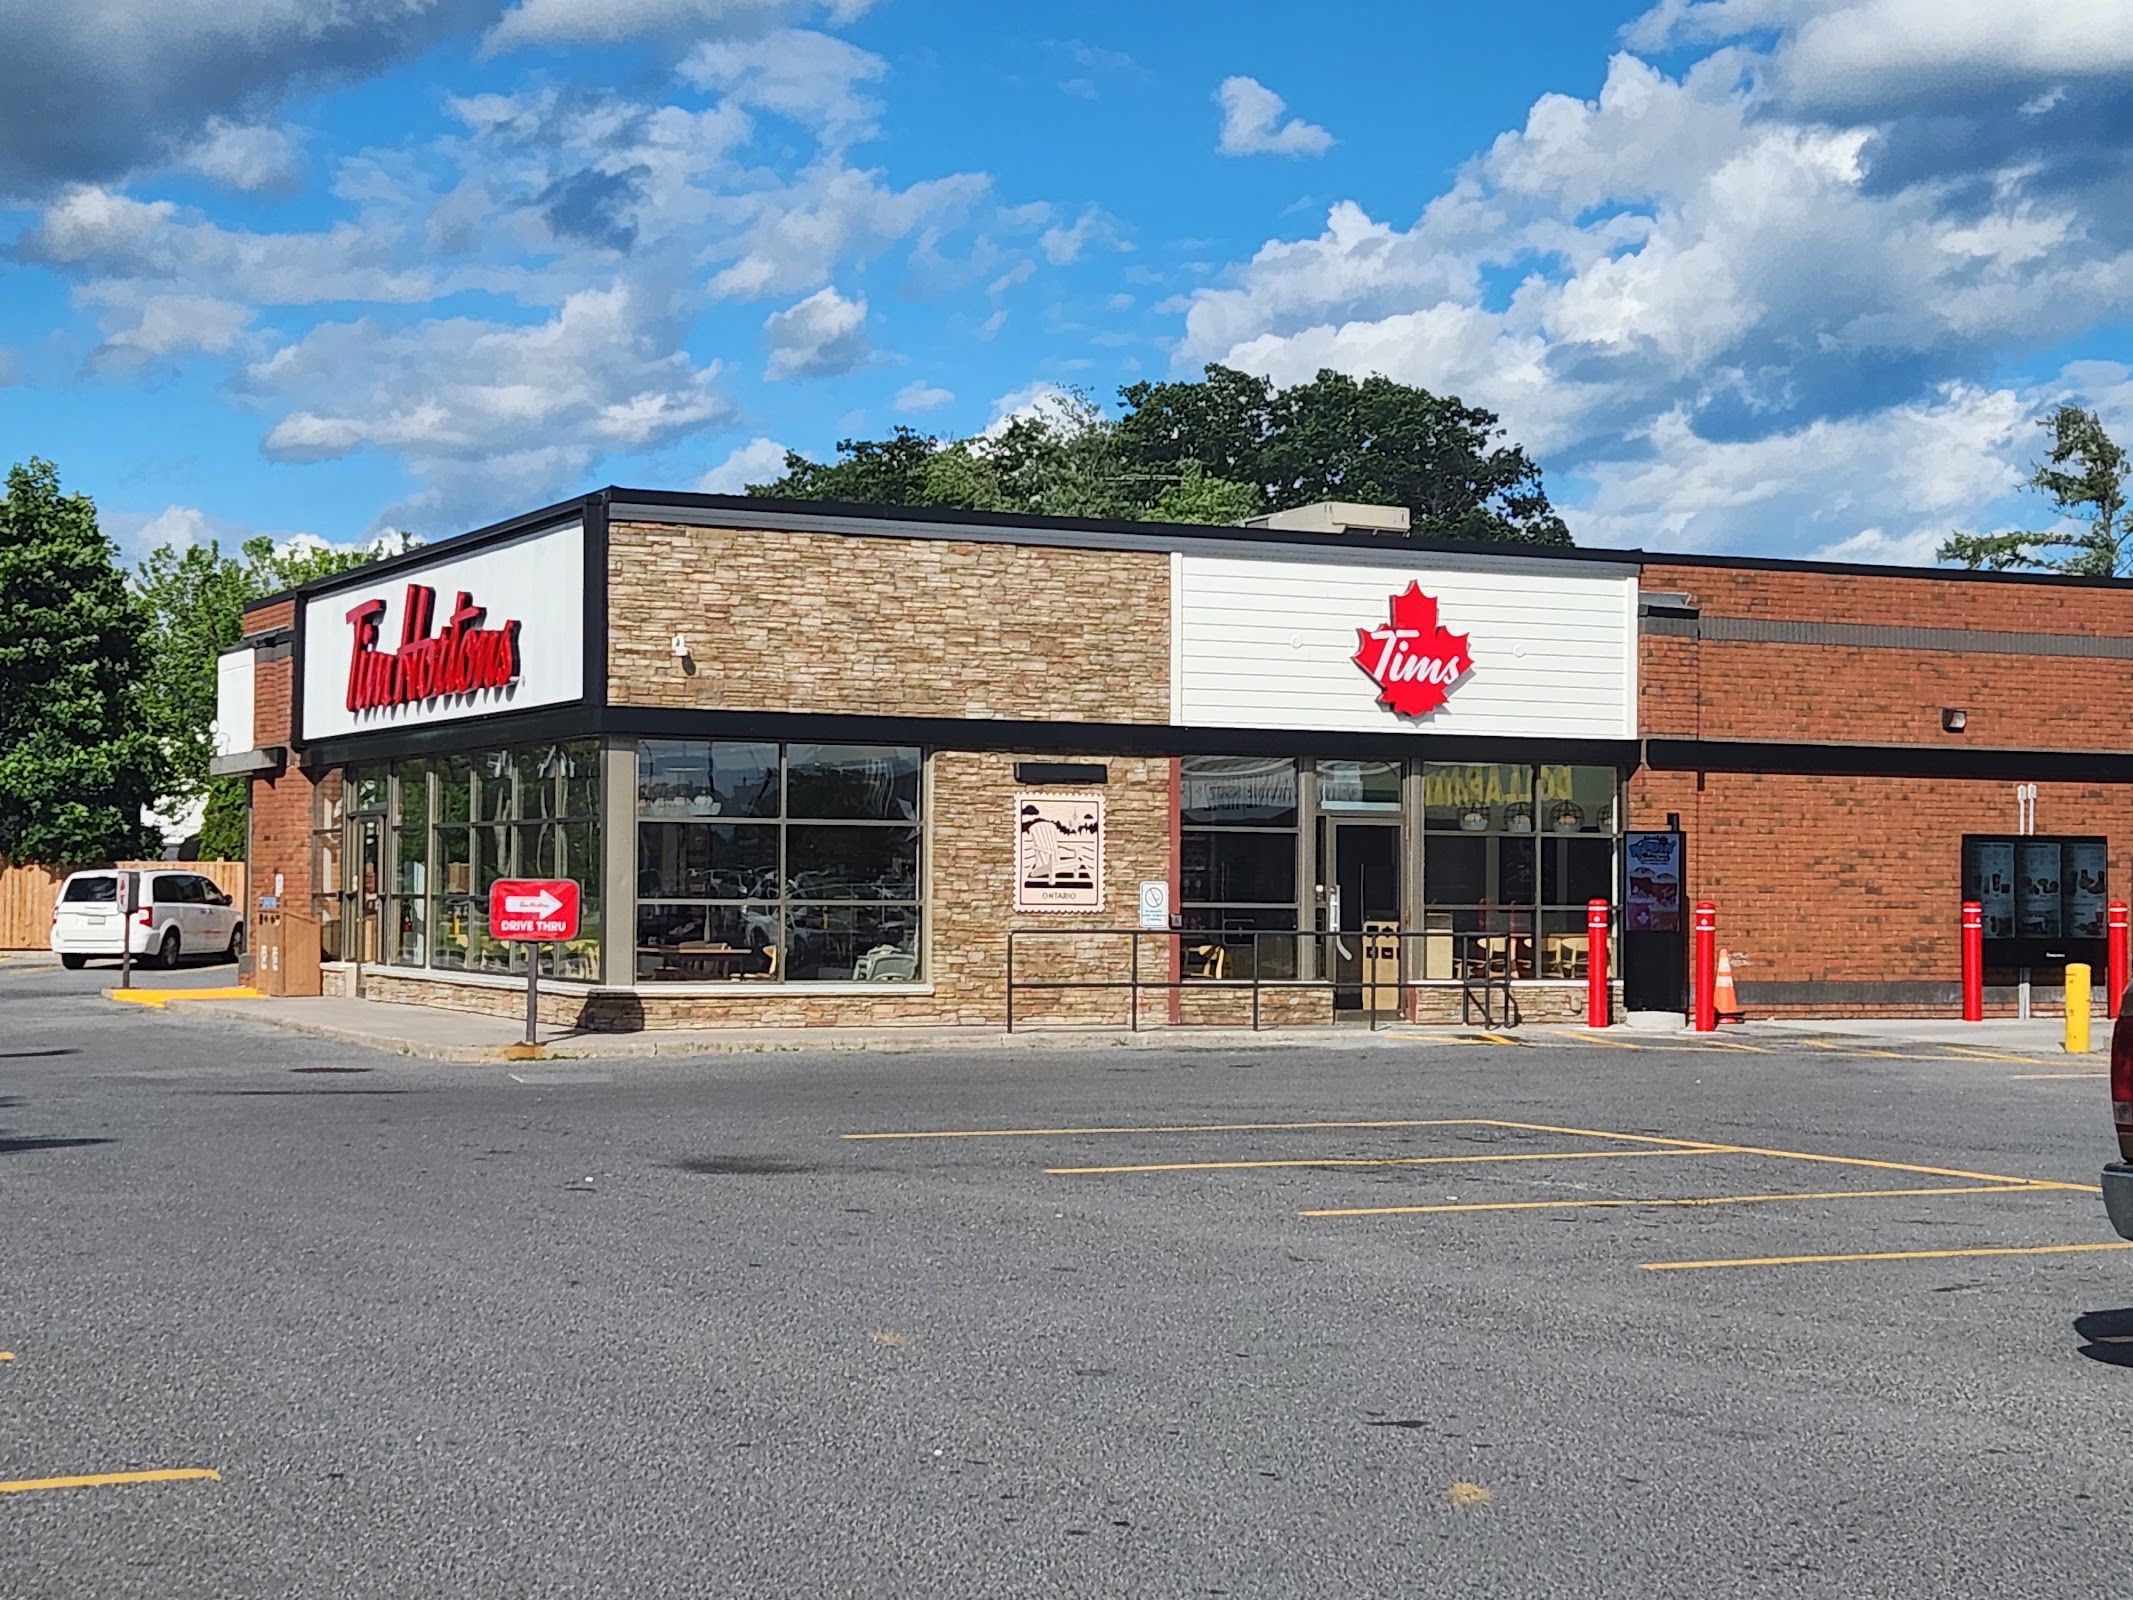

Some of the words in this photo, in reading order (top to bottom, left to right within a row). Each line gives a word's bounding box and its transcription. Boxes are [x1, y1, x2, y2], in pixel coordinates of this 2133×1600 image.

[1370, 629, 1460, 685] Tims
[1041, 891, 1077, 900] ONTARIO
[501, 920, 534, 932] DRIVE
[536, 921, 567, 932] THRU
